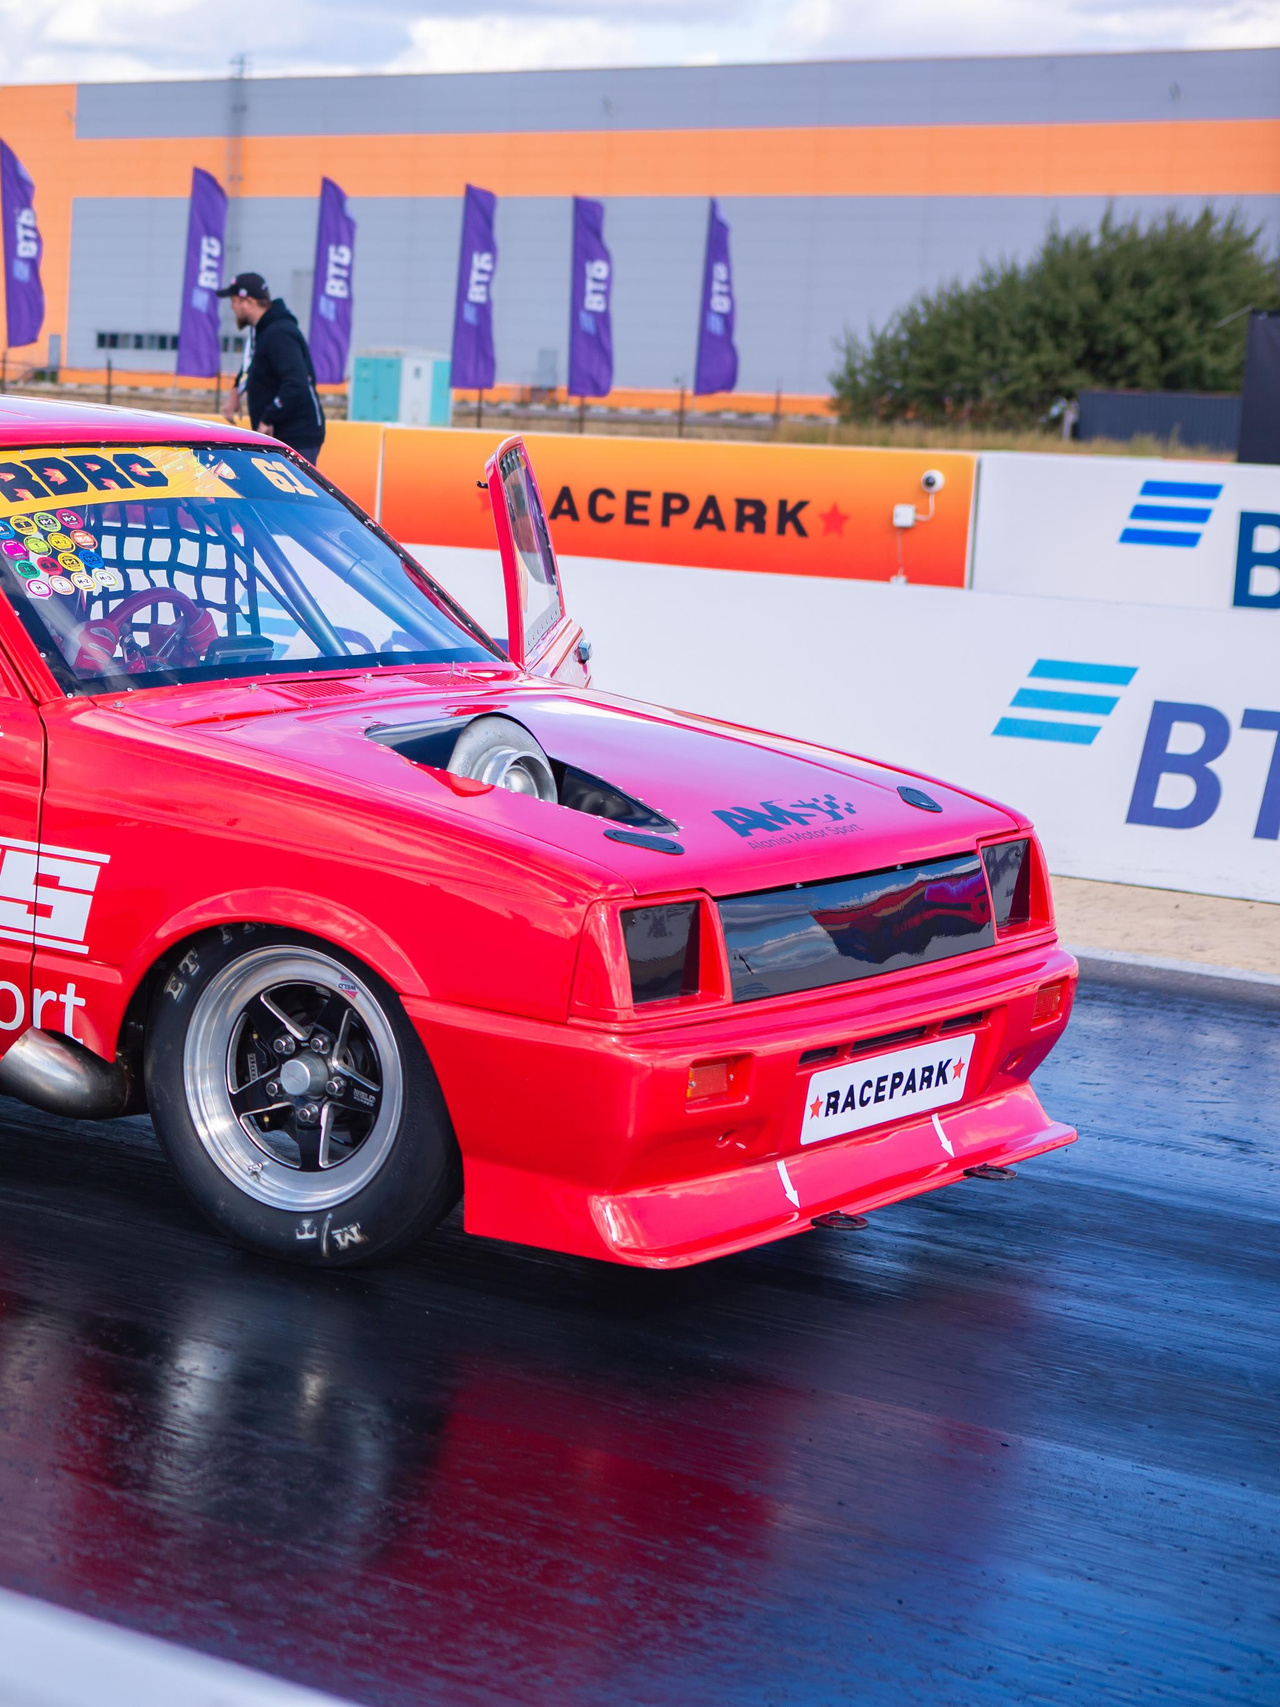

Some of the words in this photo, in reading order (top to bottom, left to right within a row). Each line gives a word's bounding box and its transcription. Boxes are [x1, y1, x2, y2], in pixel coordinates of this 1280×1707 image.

[198, 235, 220, 290] ВТБ
[324, 244, 351, 299] ВТБ
[467, 251, 494, 304] ВТБ
[584, 259, 610, 313] ВТБ
[251, 457, 319, 497] 61
[549, 485, 810, 538] ACEPARK
[746, 834, 792, 851] Alania
[789, 828, 828, 844] Motor
[825, 823, 865, 838] Sport
[824, 1057, 953, 1118] RACEPARK
